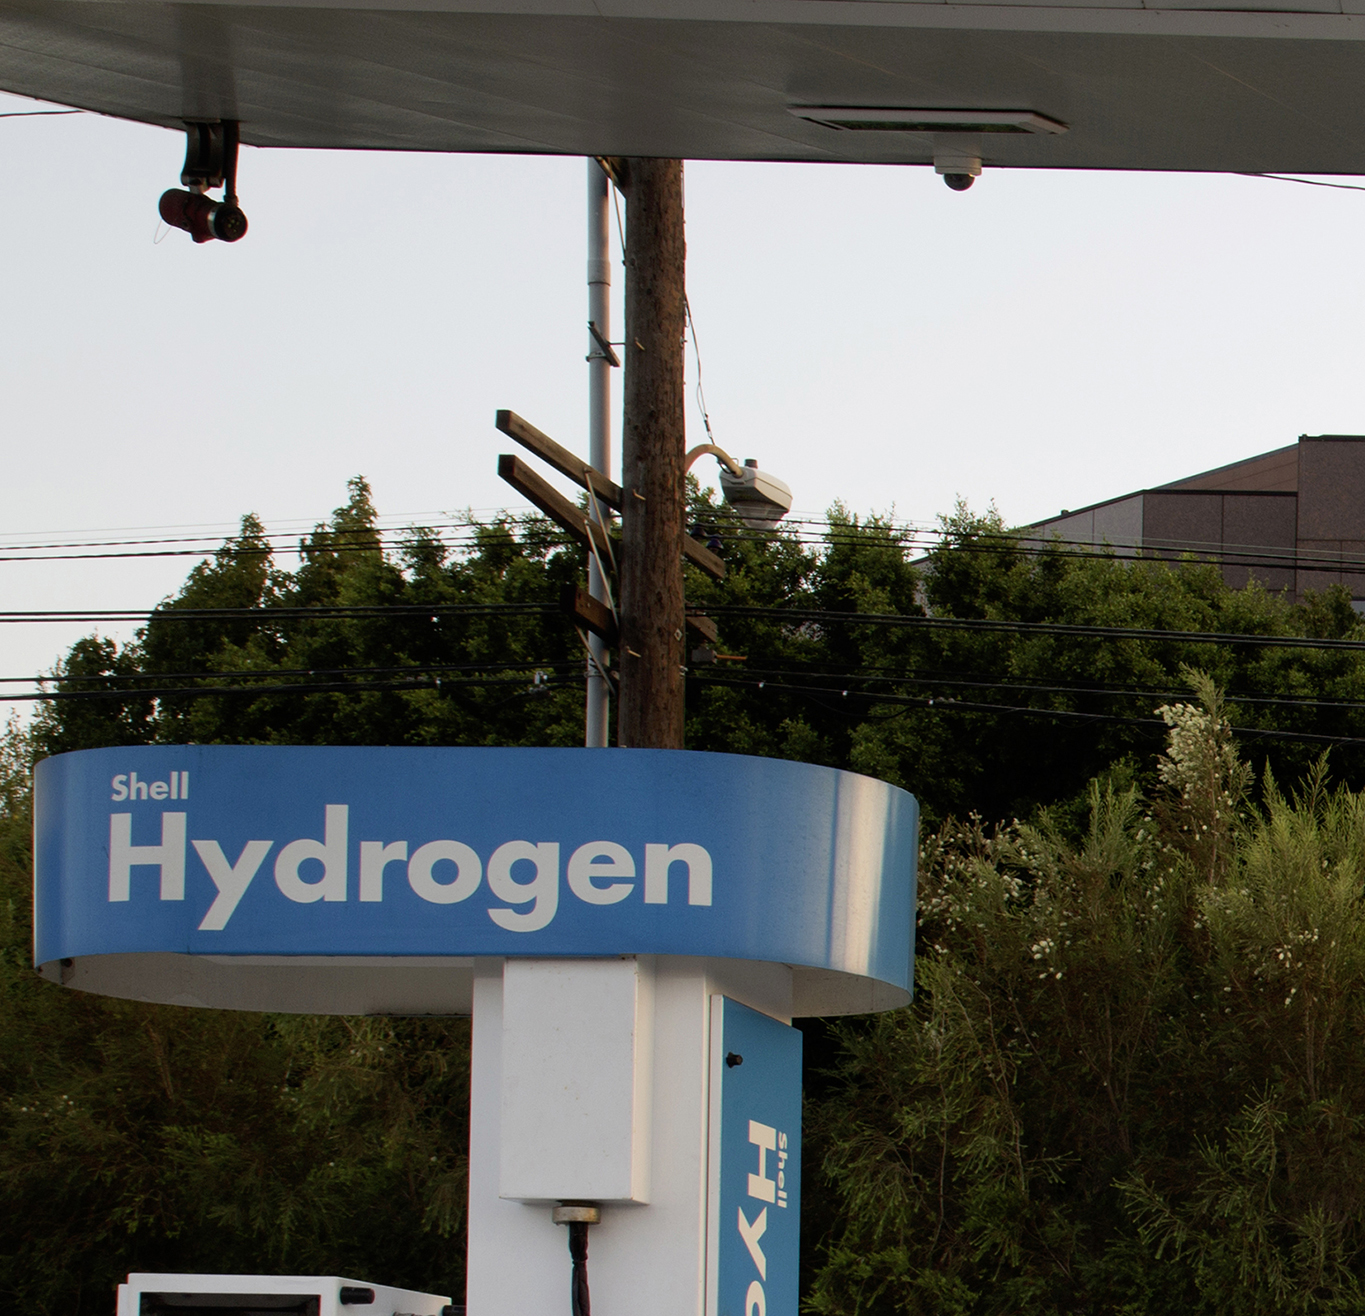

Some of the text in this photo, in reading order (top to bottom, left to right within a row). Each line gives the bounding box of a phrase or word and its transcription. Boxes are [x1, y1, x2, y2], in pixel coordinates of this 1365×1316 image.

[111, 772, 189, 801] Shell
[109, 804, 713, 932] Hydrogen
[777, 1131, 788, 1208] Shell
